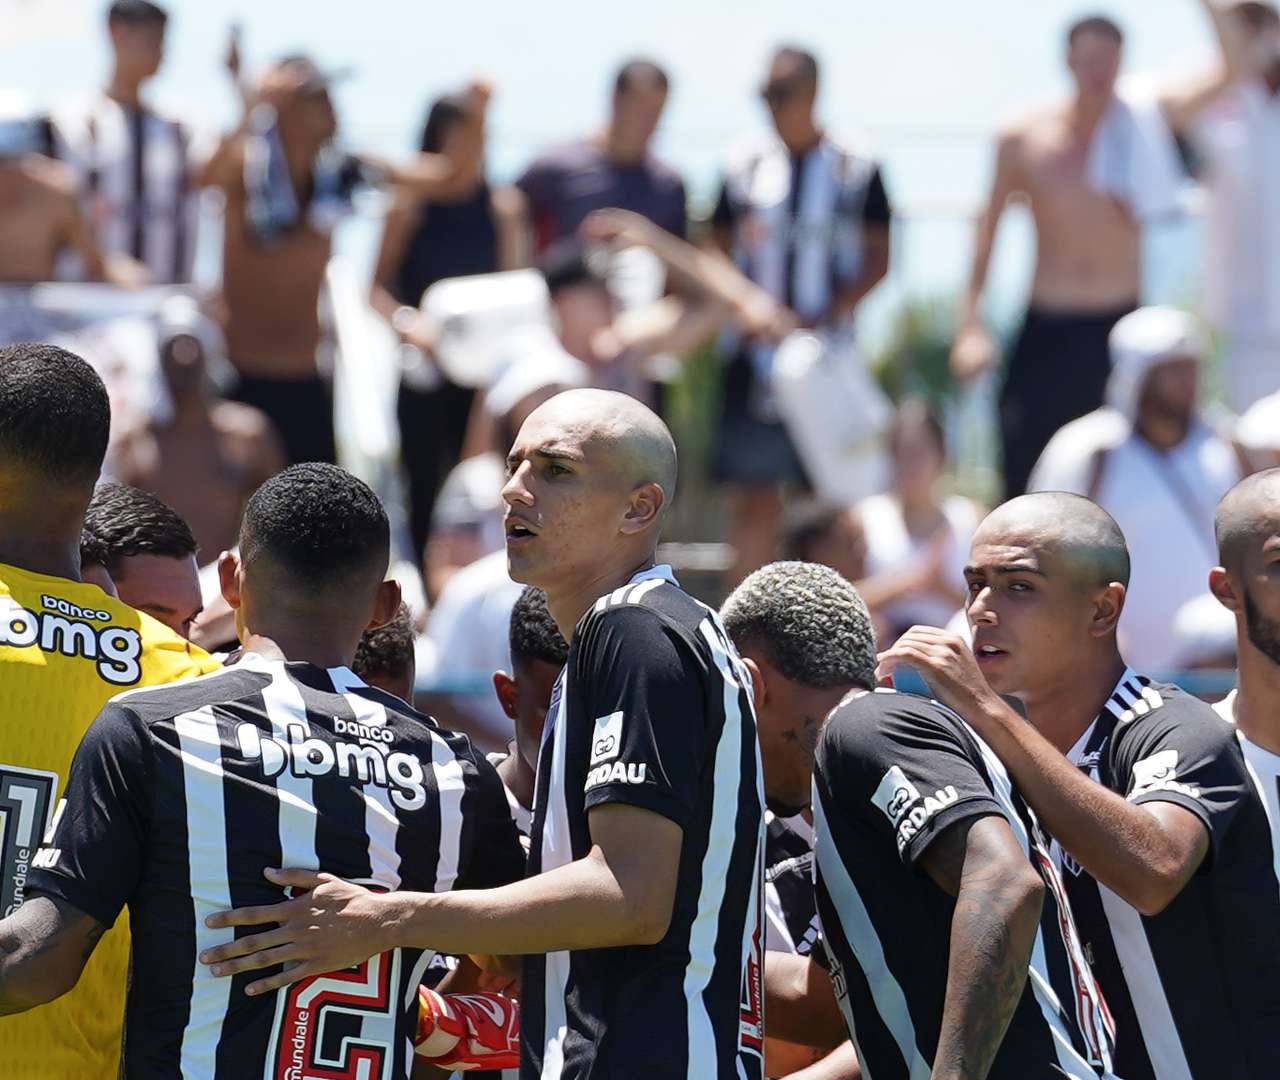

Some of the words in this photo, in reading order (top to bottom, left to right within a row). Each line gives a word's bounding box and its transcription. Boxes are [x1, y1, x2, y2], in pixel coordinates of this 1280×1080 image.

[41, 595, 112, 621] banco
[333, 715, 395, 744] banco
[289, 724, 426, 811] bmg
